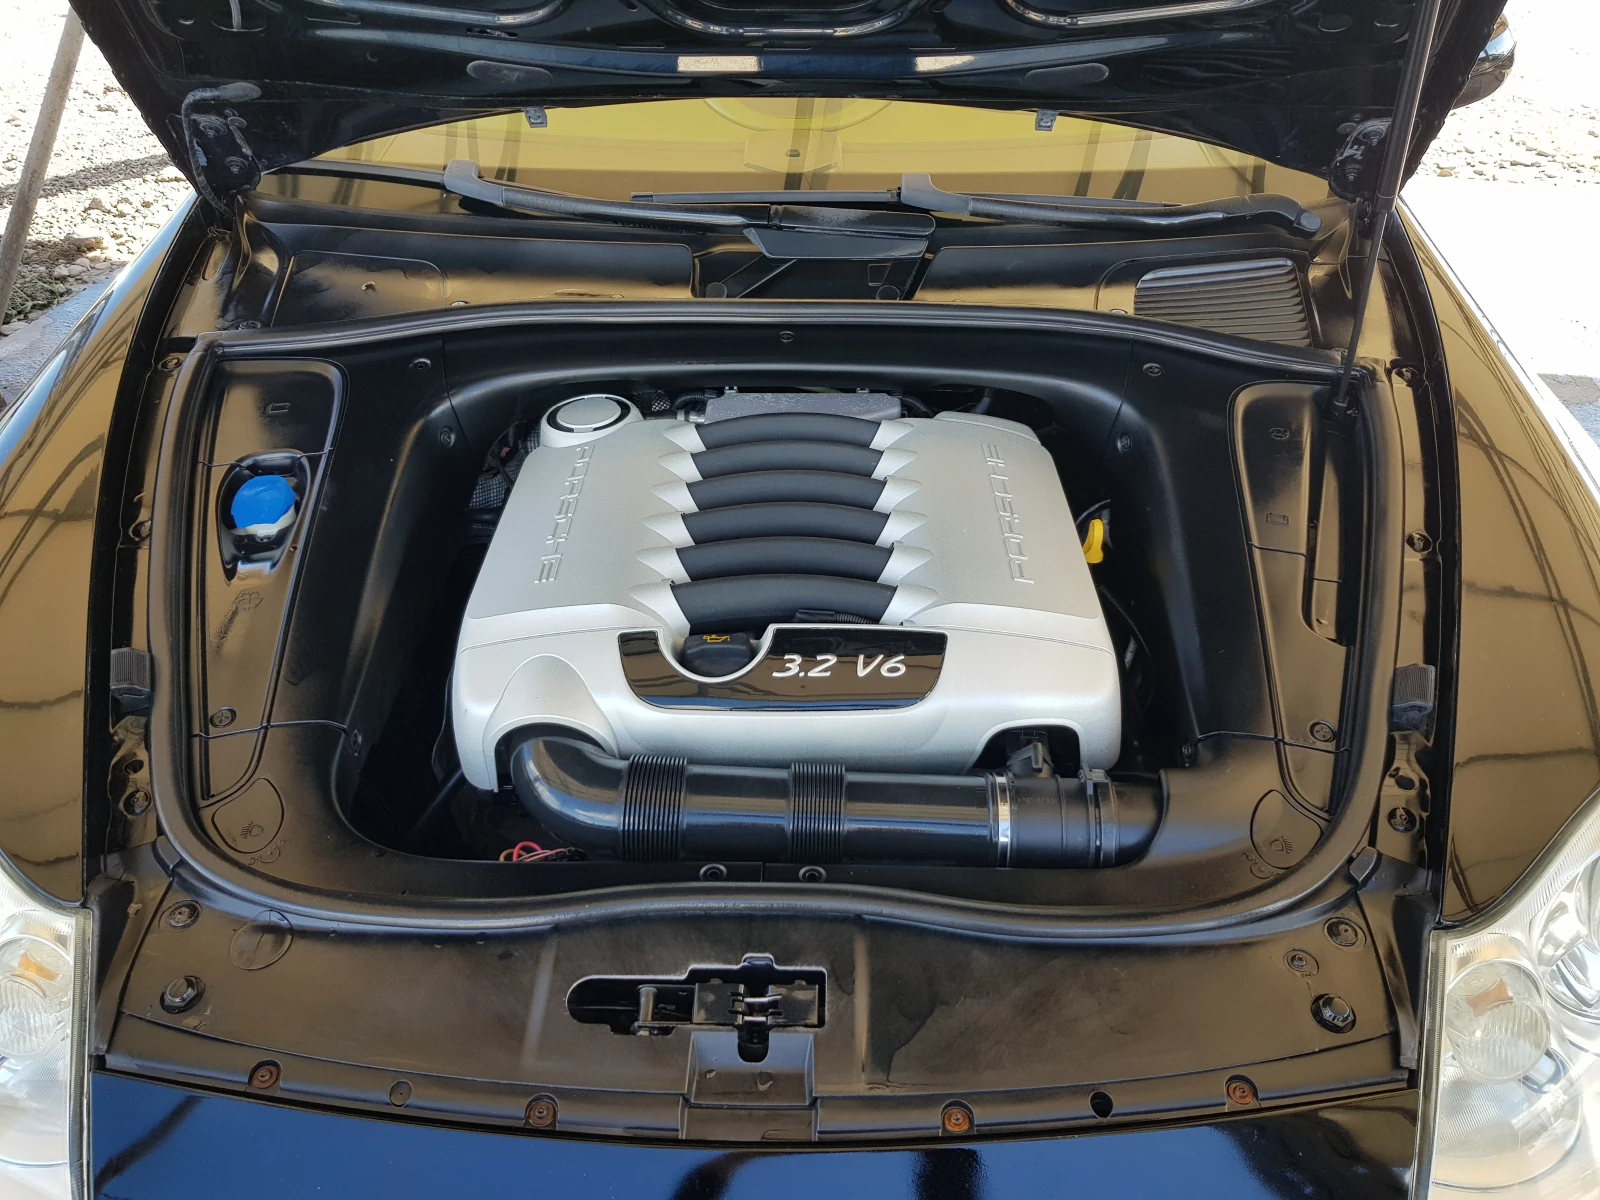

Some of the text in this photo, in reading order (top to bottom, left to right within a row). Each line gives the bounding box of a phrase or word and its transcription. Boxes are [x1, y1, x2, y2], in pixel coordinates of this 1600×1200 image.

[534, 444, 595, 583] PORSCHE
[982, 443, 1035, 584] PORSCHE
[772, 653, 906, 677] 3.2 V6
